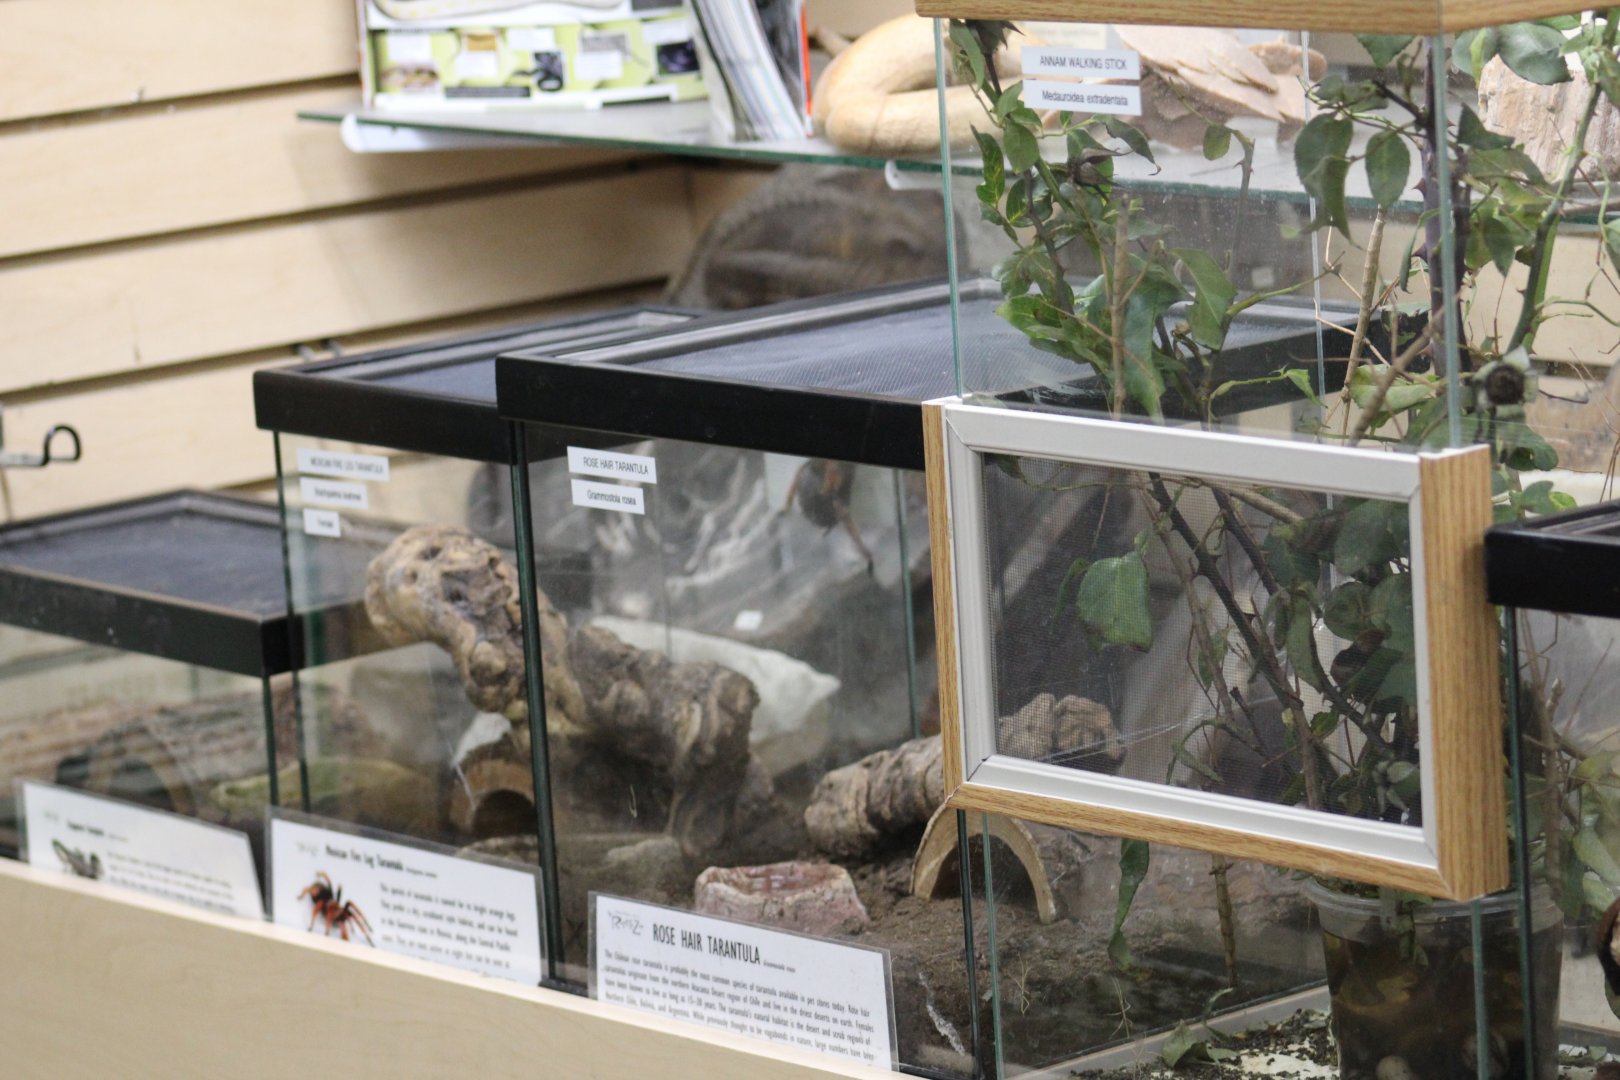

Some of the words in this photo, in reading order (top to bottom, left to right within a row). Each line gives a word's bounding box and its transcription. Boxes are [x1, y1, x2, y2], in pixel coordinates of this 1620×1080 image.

[1039, 55, 1066, 67] ANNAM
[1068, 56, 1102, 68] WALKING
[1104, 58, 1127, 70] STICK
[1042, 90, 1084, 103] Medauroidea
[1086, 93, 1128, 106] extradentata
[583, 455, 598, 468] ROSE
[600, 457, 613, 470] HAIR
[615, 460, 648, 474] TARANTULA
[652, 923, 675, 946] ROSE
[680, 929, 702, 952] HAIR
[707, 935, 760, 965] TARANTULA
